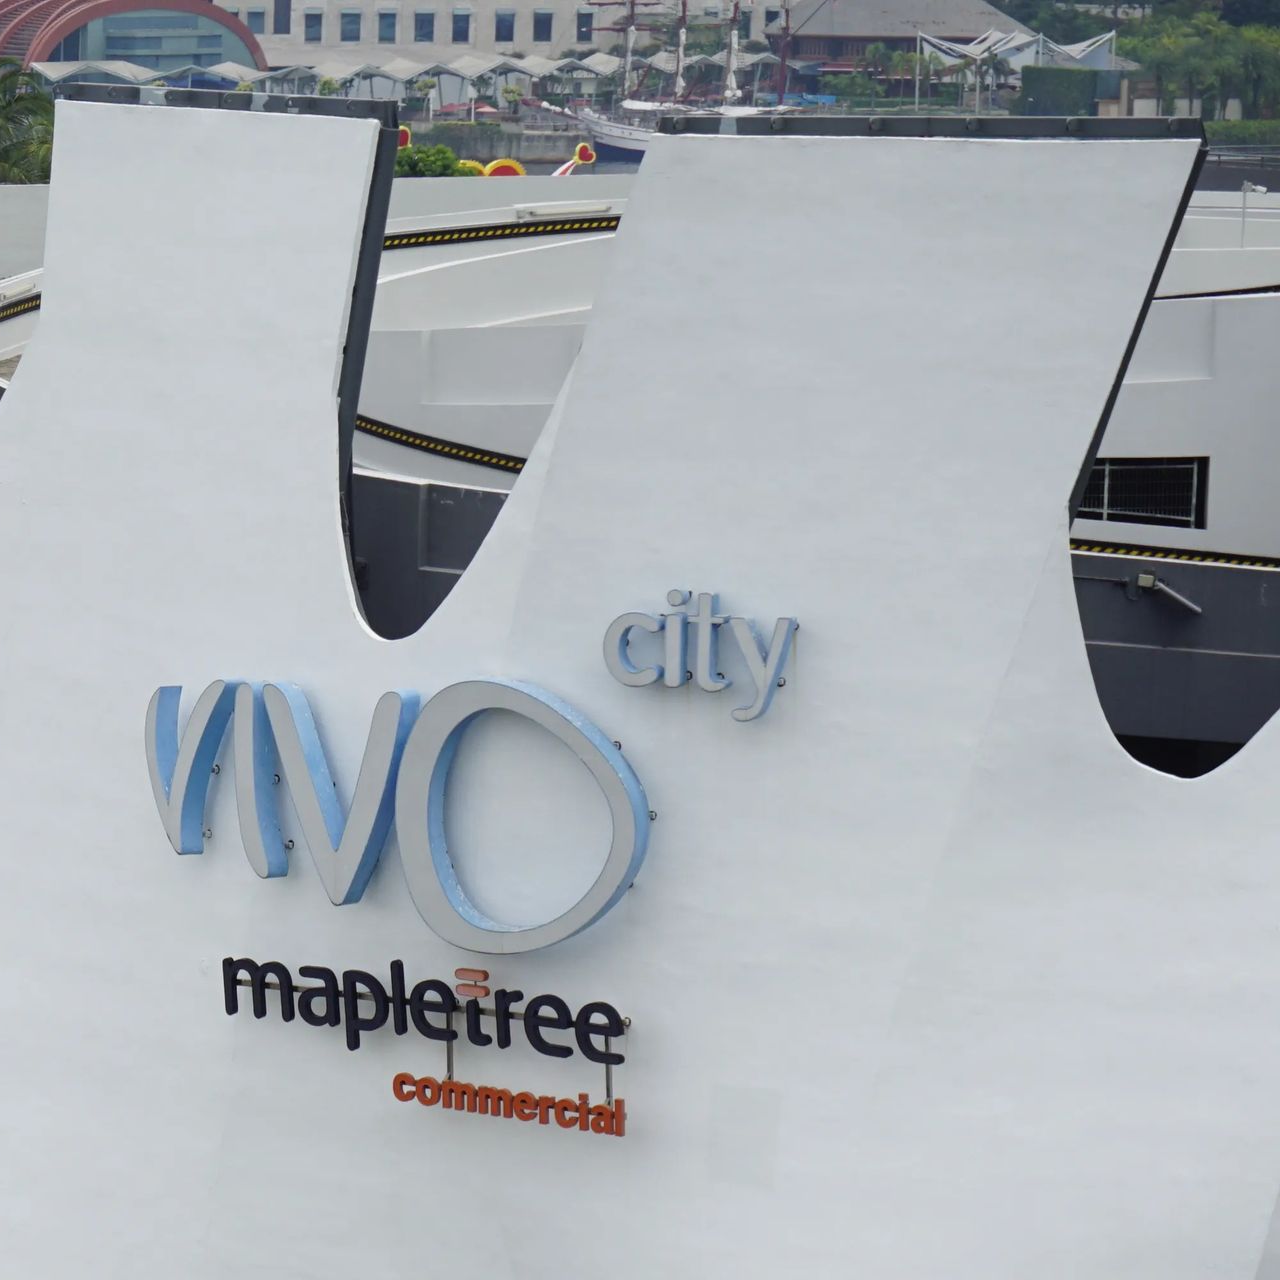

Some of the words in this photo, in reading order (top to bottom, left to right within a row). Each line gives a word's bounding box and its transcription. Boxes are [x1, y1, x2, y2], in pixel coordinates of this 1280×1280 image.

[603, 588, 797, 722] city
[222, 956, 625, 1065] mapletree
[392, 1071, 626, 1137] commercial
